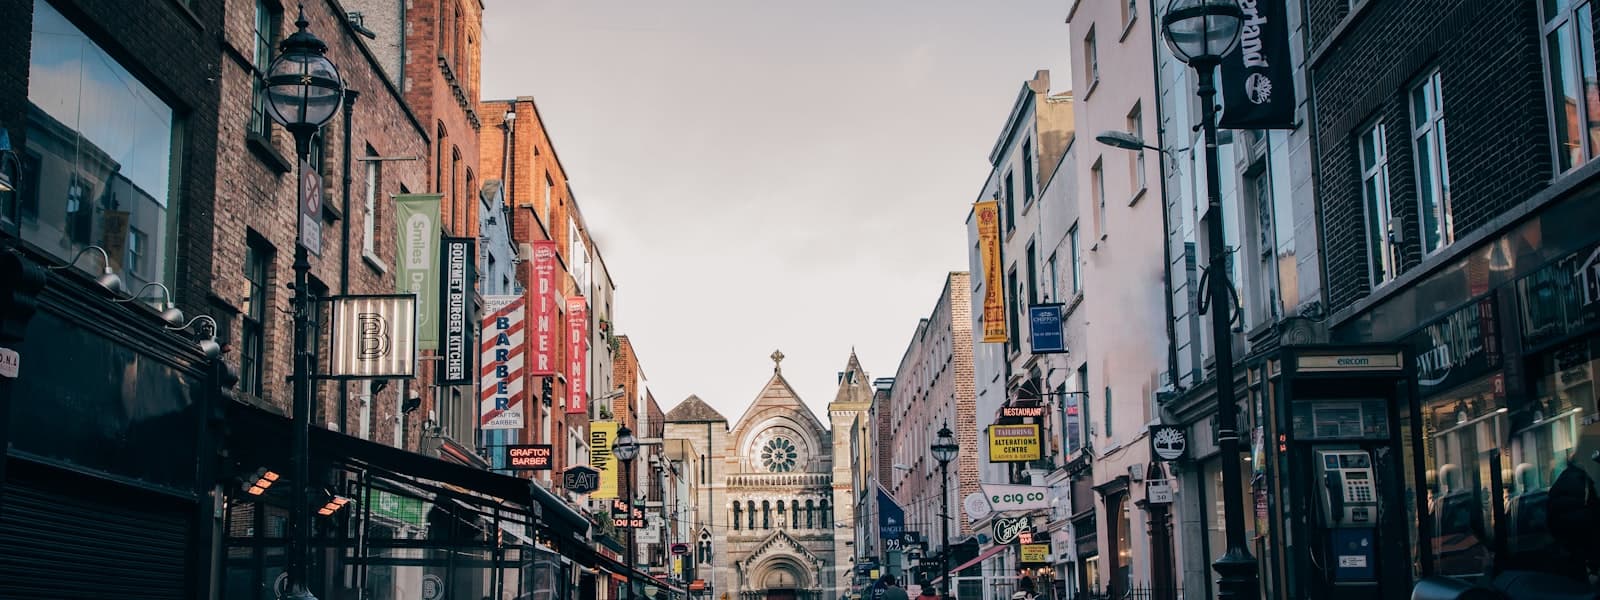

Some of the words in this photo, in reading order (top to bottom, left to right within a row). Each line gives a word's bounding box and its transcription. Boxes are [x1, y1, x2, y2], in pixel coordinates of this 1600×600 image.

[412, 219, 425, 265] Smiles
[451, 242, 463, 292] GOURMET
[450, 294, 462, 334] BURGER
[538, 278, 549, 371] DINER
[358, 313, 391, 360] B
[449, 337, 461, 380] KITCHEN
[495, 316, 511, 411] BARBER
[572, 329, 580, 409] DINER
[1003, 407, 1042, 416] RESTAURANT
[509, 448, 550, 457] GRAFTON
[512, 457, 547, 465] BARBER
[995, 438, 1037, 446] ALTERATIONS
[565, 471, 597, 489] EAT
[992, 495, 1000, 503] e
[1003, 493, 1024, 504] cig
[1027, 492, 1044, 501] co
[887, 540, 900, 550] 22
